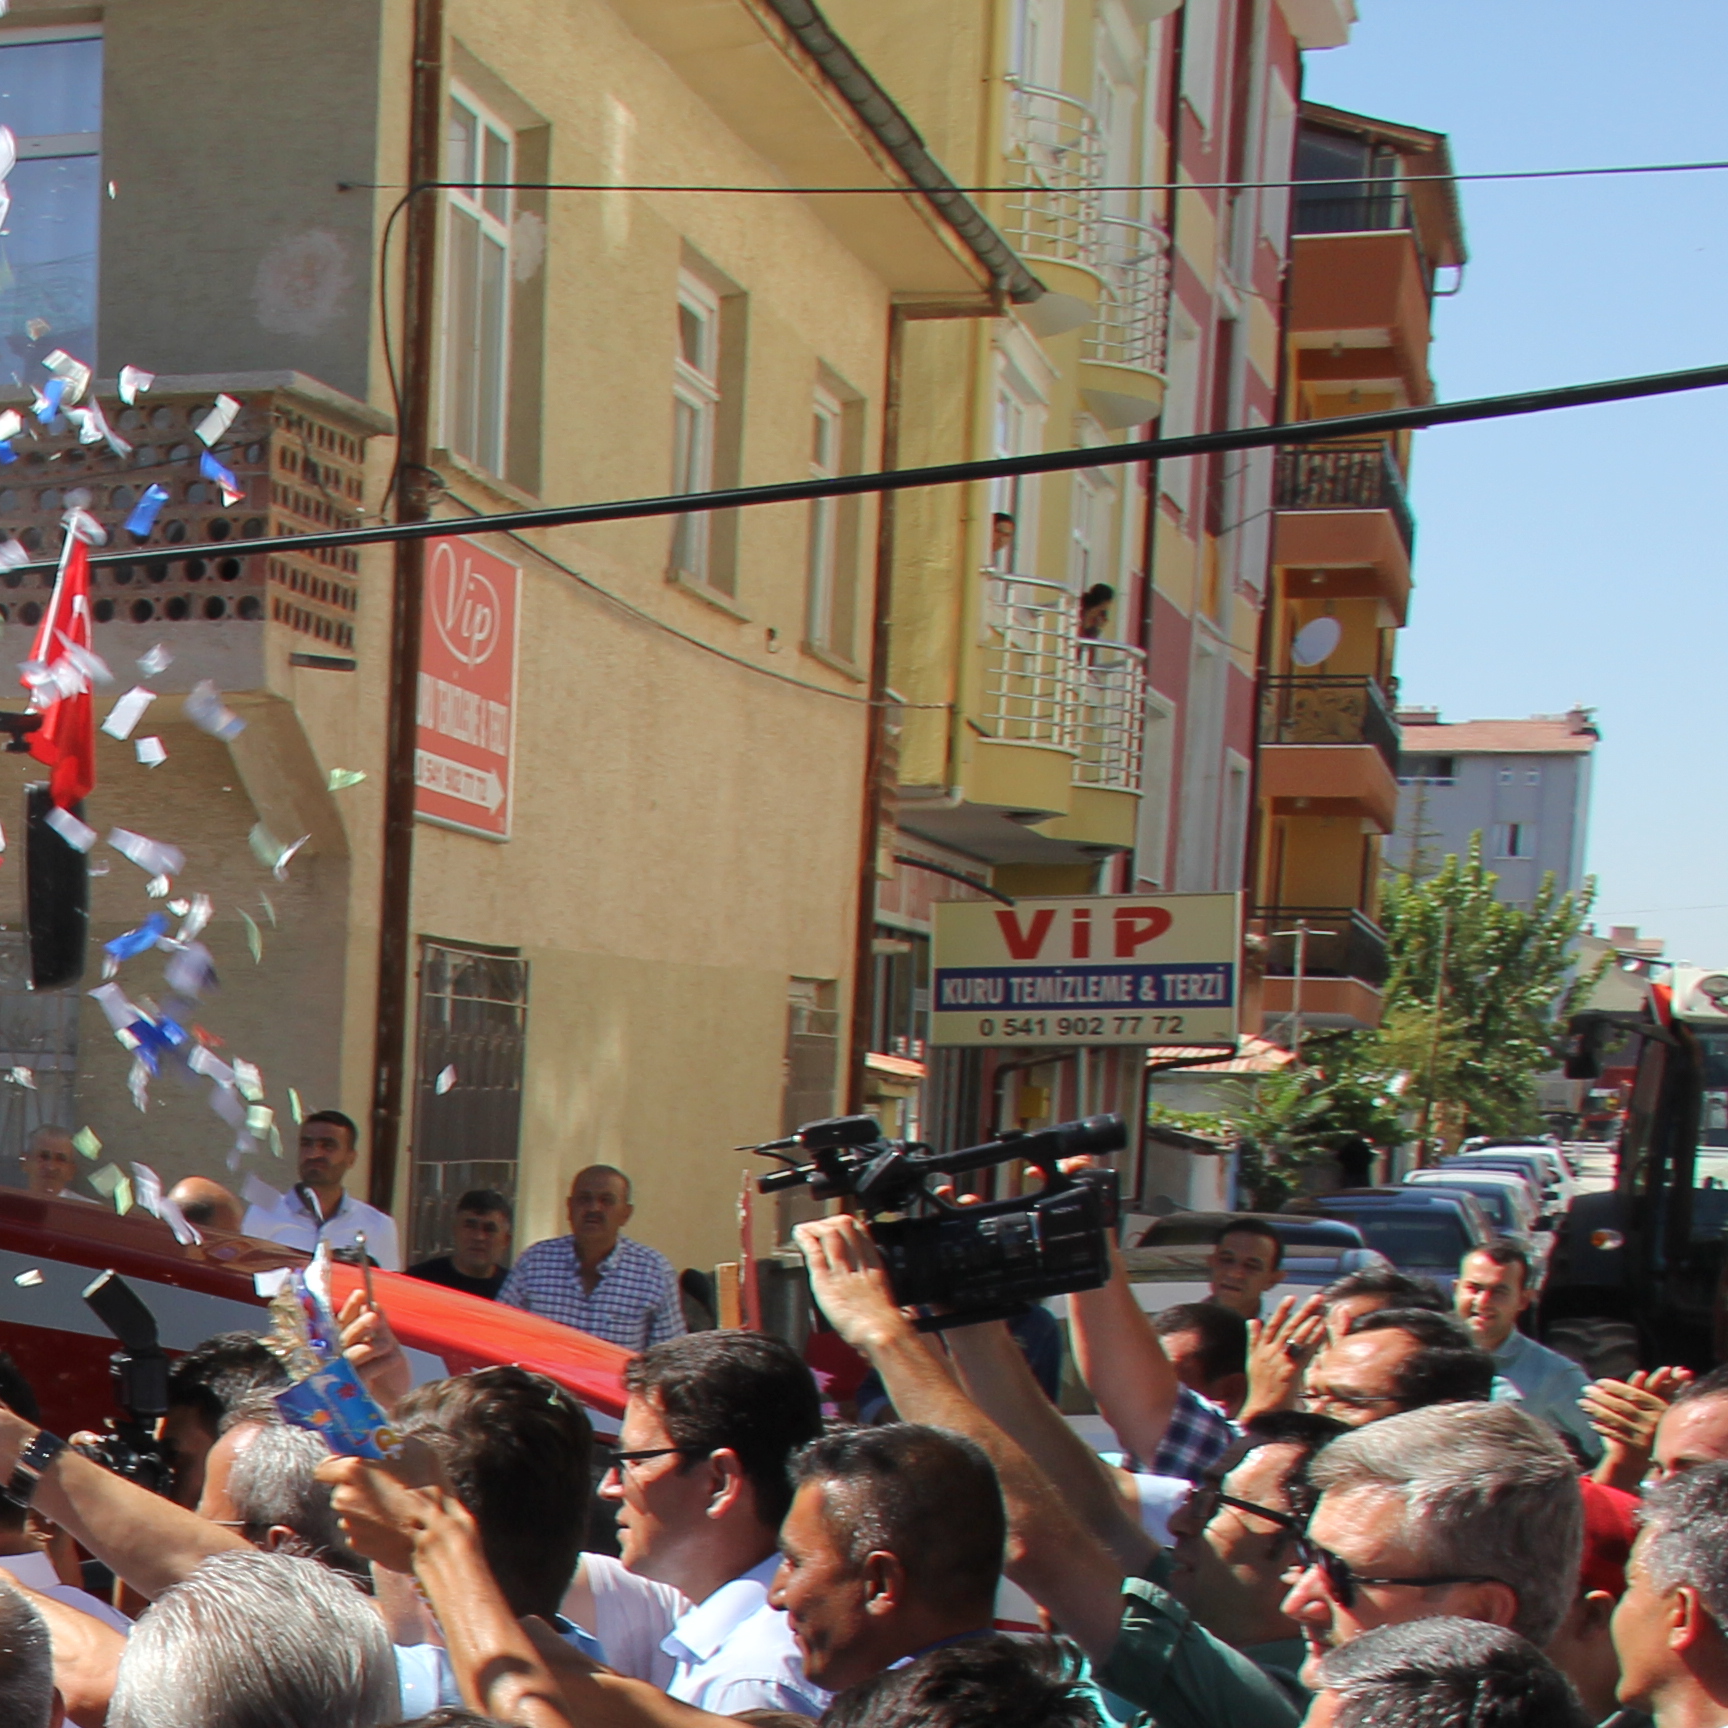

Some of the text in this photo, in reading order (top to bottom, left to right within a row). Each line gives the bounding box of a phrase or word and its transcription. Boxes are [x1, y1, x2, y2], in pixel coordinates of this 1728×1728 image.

[942, 966, 1225, 1004] KURU TEMİZLEME & TERZİ
[979, 1015, 1184, 1036] 0 541 902 77 72
